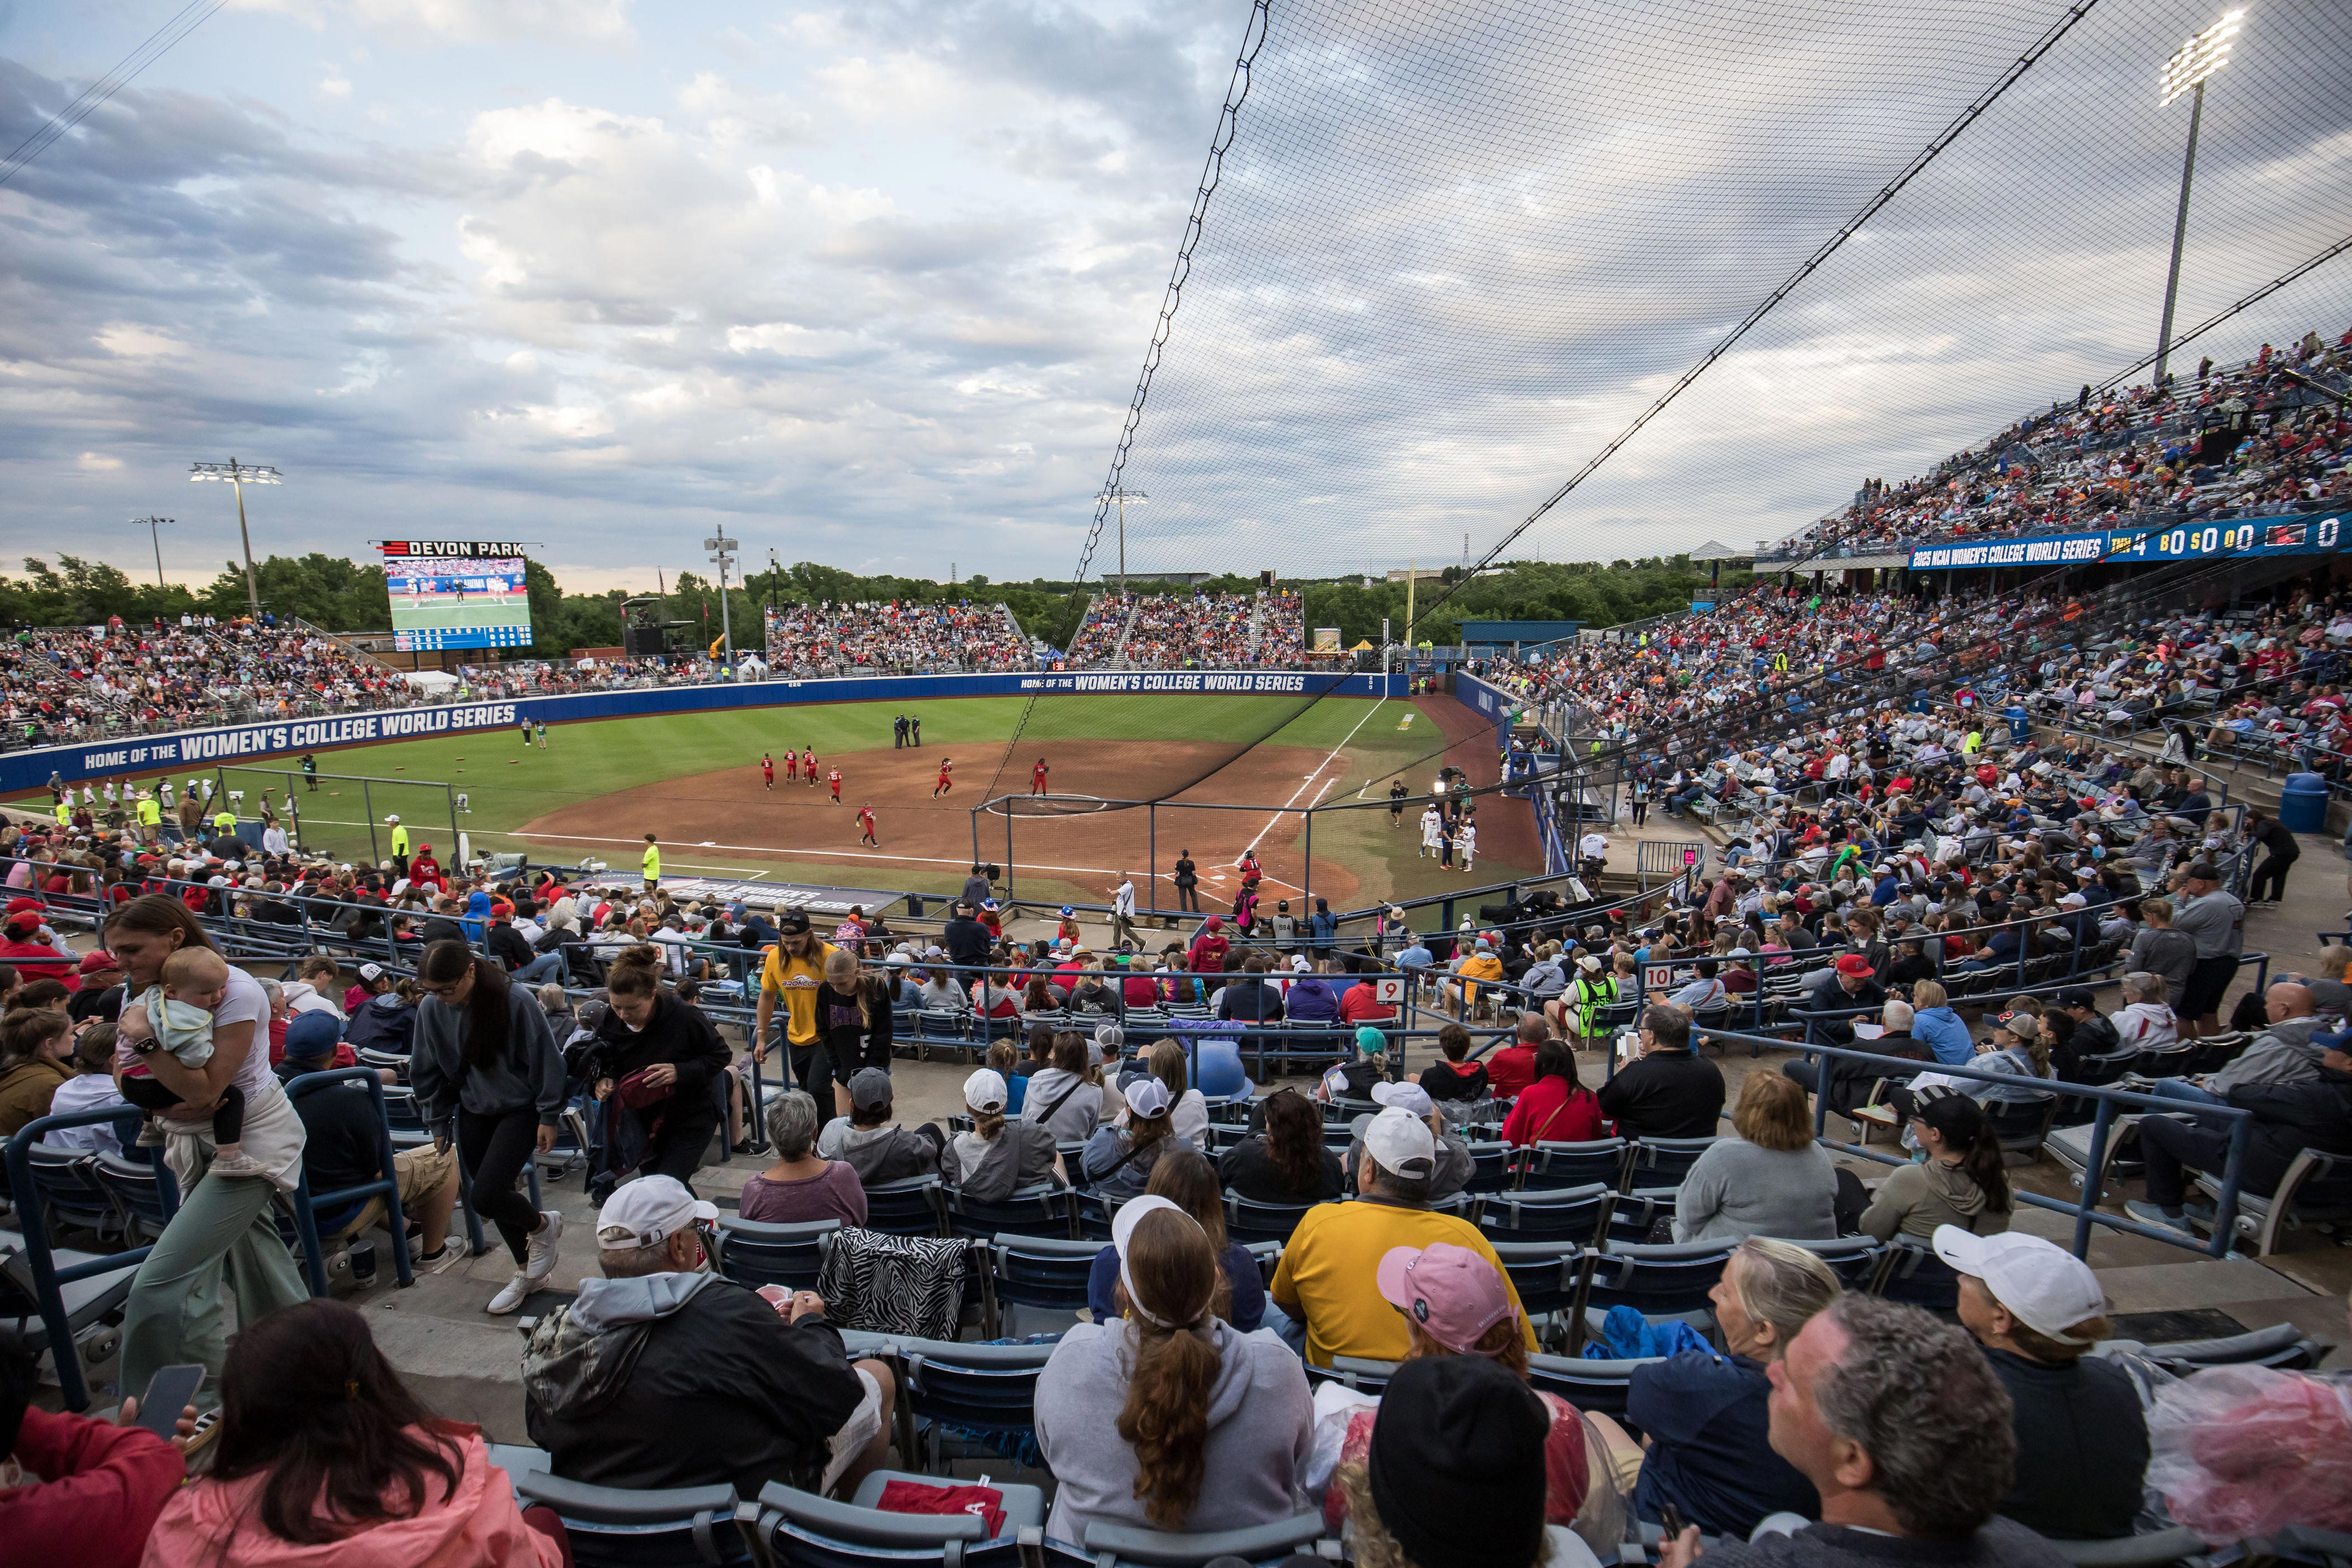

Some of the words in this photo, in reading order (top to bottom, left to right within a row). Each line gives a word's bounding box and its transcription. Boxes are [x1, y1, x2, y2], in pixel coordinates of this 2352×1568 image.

[409, 542, 471, 555] DEVON
[478, 543, 523, 555] PARK
[2133, 533, 2146, 555] 4
[2160, 535, 2169, 551] B
[2190, 532, 2200, 549] S
[1912, 550, 1931, 566] 2025
[1931, 547, 1951, 565] NCAA
[1951, 546, 1987, 564] WOMEN'S
[1988, 544, 2024, 563] COLLEGE
[2026, 541, 2058, 561] WORLD
[2061, 538, 2101, 559] SERIES
[1021, 679, 1044, 688] HOME
[1058, 679, 1073, 687] THE
[1075, 676, 1141, 690] WOMEN'S
[1144, 675, 1200, 689] COLLEGE
[1205, 676, 1253, 690] WORLD
[1255, 676, 1304, 691] SERIES
[85, 751, 127, 769] HOME
[130, 748, 148, 763] OF
[151, 744, 177, 759] THE
[181, 726, 287, 761] WOMEN'S
[291, 718, 376, 747] COLLEGE
[381, 711, 448, 736] WORLD
[452, 705, 516, 728] SERIES
[686, 883, 738, 892] NCAA
[737, 885, 821, 899] WOMEN'S
[743, 894, 809, 906] WORLD
[804, 900, 875, 911] SERIES
[1649, 969, 1668, 985] 10
[1385, 983, 1397, 998] 9
[105, 1342, 112, 1350] R
